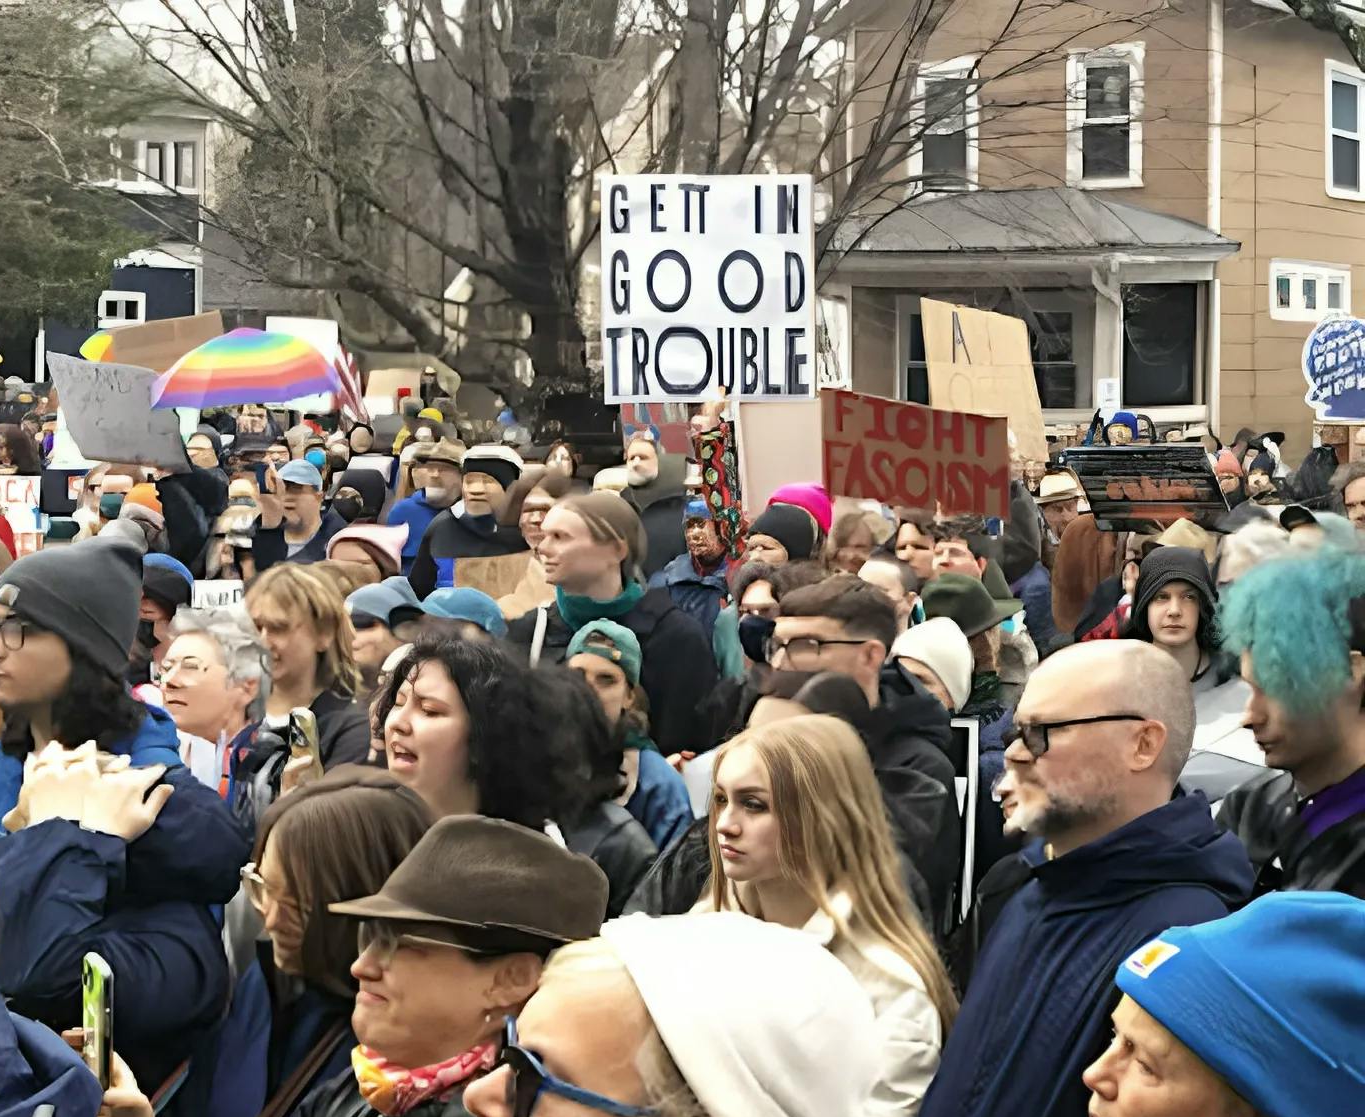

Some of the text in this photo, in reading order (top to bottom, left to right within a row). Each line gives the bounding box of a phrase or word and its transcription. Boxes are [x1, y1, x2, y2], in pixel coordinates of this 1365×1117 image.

[755, 184, 799, 234] IN
[610, 249, 806, 315] GOOD
[606, 326, 810, 396] TROUBLE
